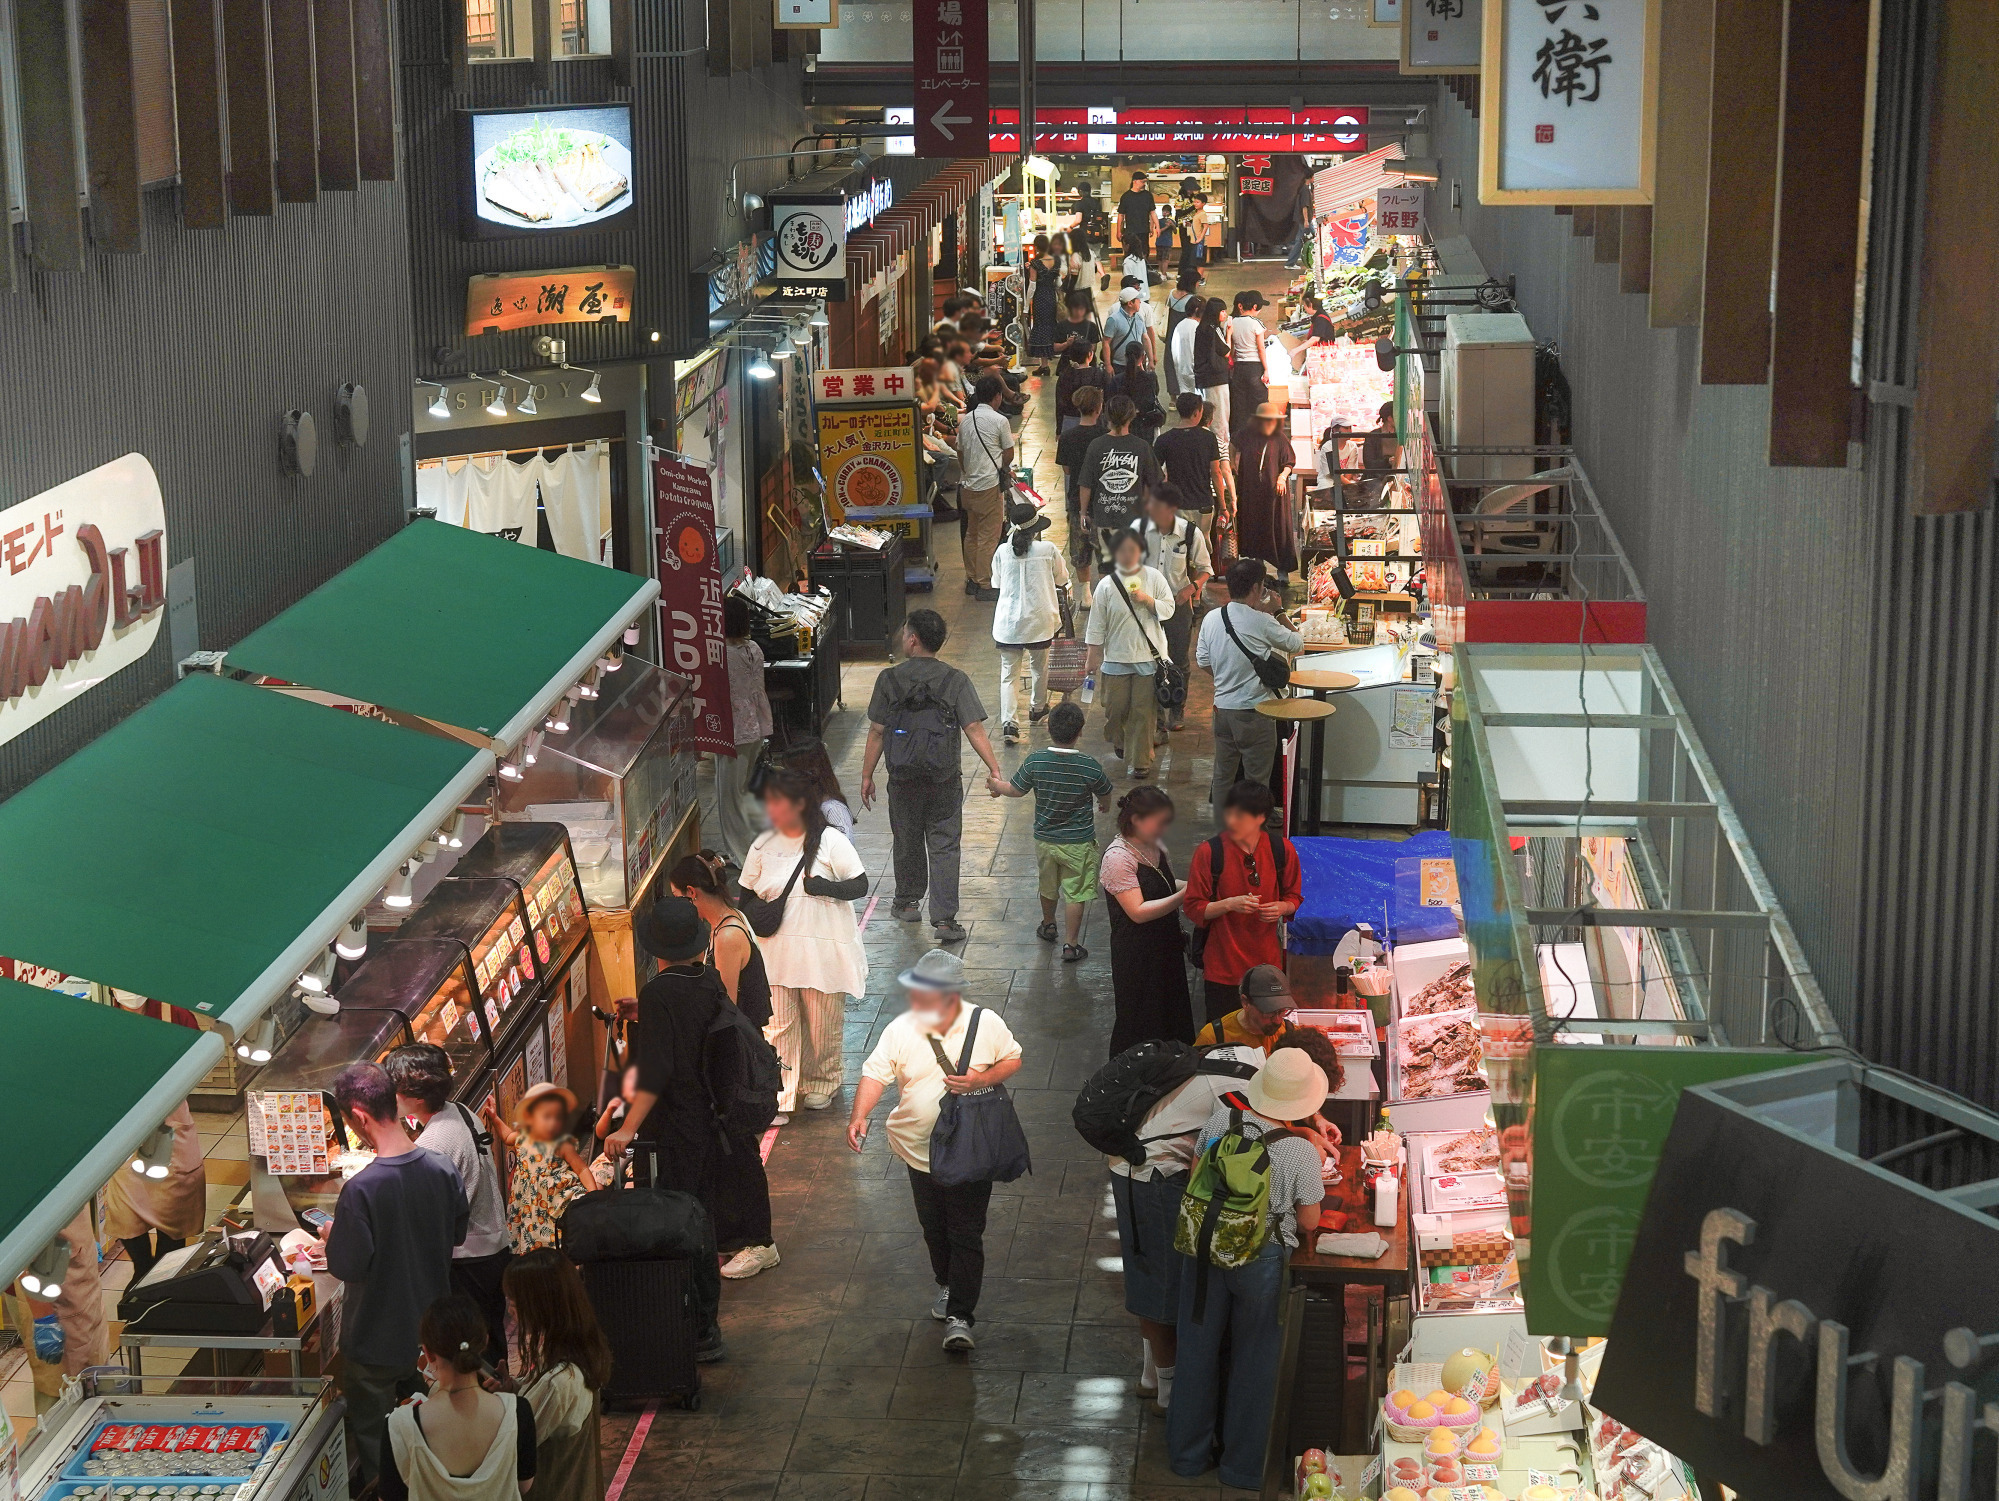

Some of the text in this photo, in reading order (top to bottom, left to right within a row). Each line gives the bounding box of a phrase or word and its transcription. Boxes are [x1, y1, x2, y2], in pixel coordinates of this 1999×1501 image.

[920, 78, 981, 90] エレベーター
[1241, 179, 1271, 193] 認定店
[1381, 195, 1419, 205] フルーツ
[1381, 211, 1419, 229] 坂野
[782, 286, 829, 297] 近江町店
[822, 373, 904, 398] 営業中
[822, 412, 910, 430] カレーのチャンピオン
[874, 428, 911, 438] 近江町店
[862, 441, 912, 452] 金沢カレー
[660, 467, 708, 487] Omi-cho Market
[837, 460, 857, 486] CURRY
[862, 456, 900, 484] CHAMPION
[660, 490, 683, 505] Potato
[672, 482, 702, 497] Kanazawa
[0, 508, 64, 576] モンド
[700, 577, 724, 669] 近江町
[1684, 1206, 1999, 1501] frui
